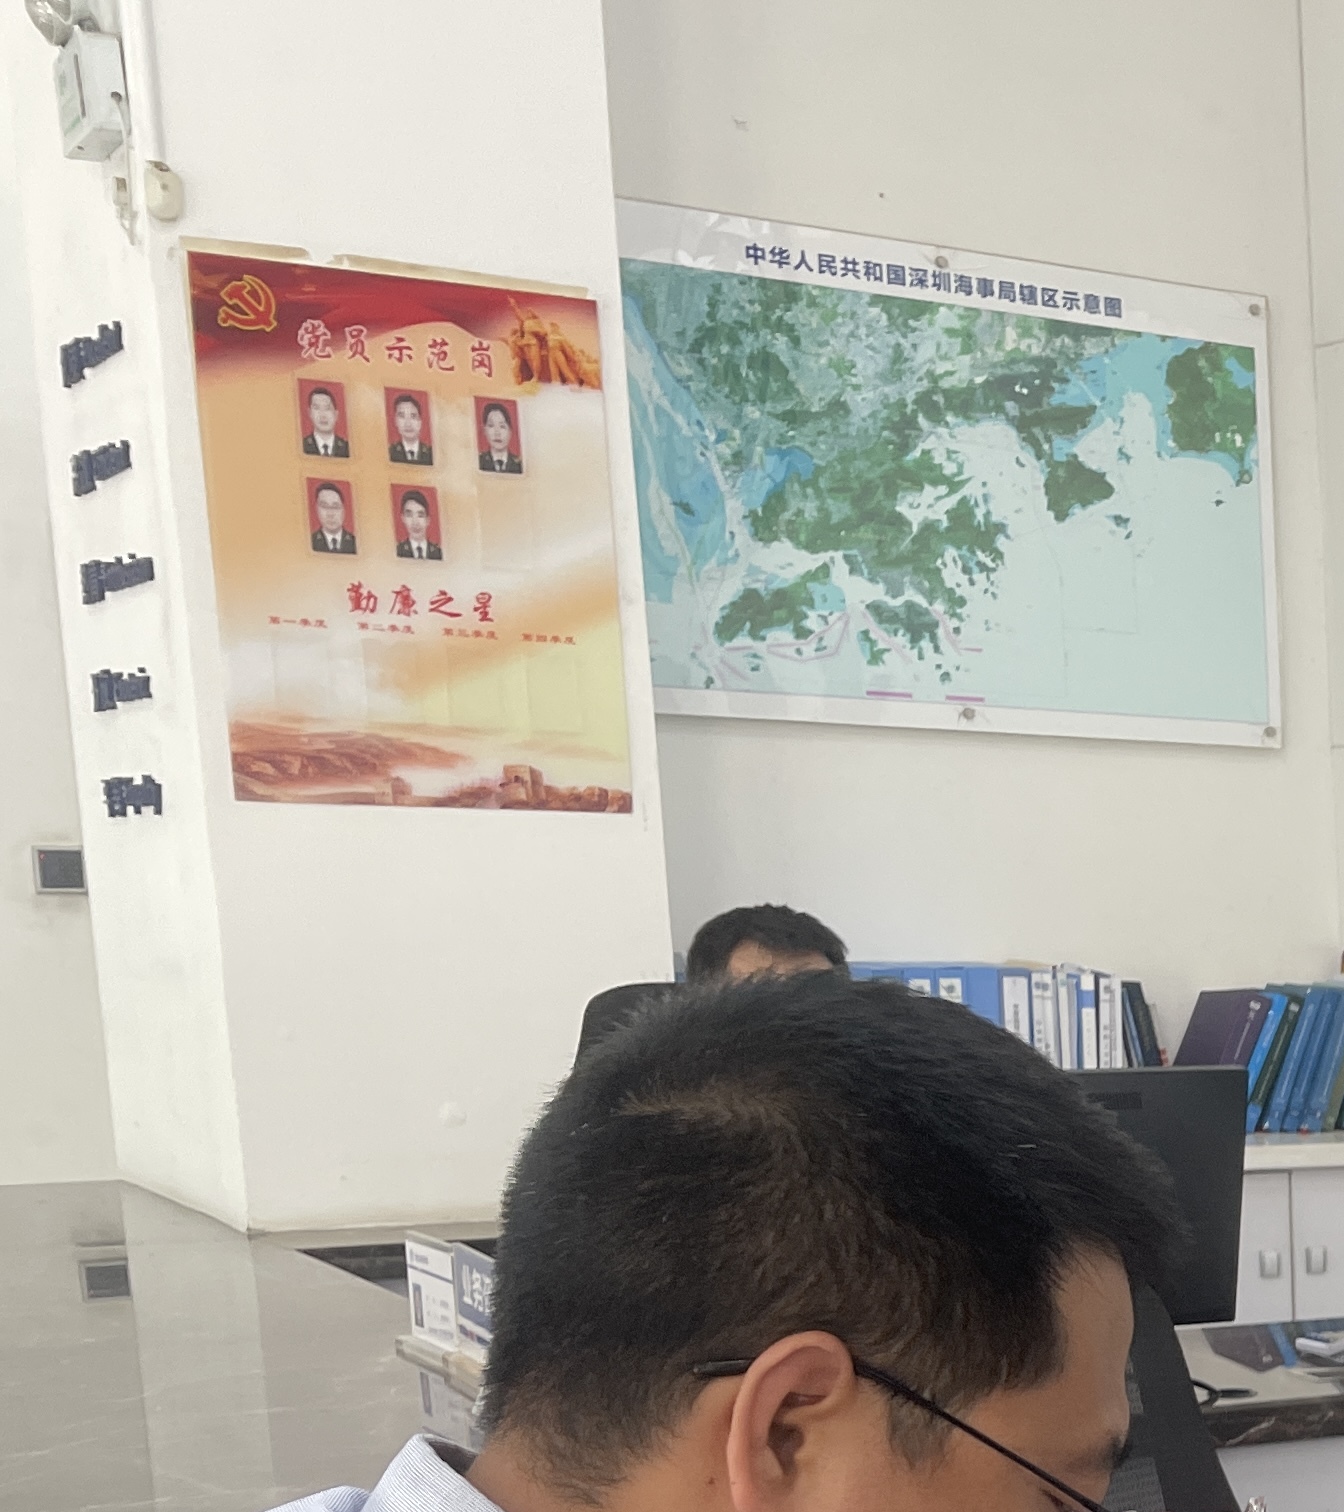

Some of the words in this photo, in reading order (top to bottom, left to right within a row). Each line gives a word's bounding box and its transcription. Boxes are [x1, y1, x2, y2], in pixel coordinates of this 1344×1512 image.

[744, 242, 1123, 319] 中华人民共和国深圳海事局辖区示意图
[297, 318, 494, 378] 党员示范岗
[346, 581, 496, 623] 勤廉之星
